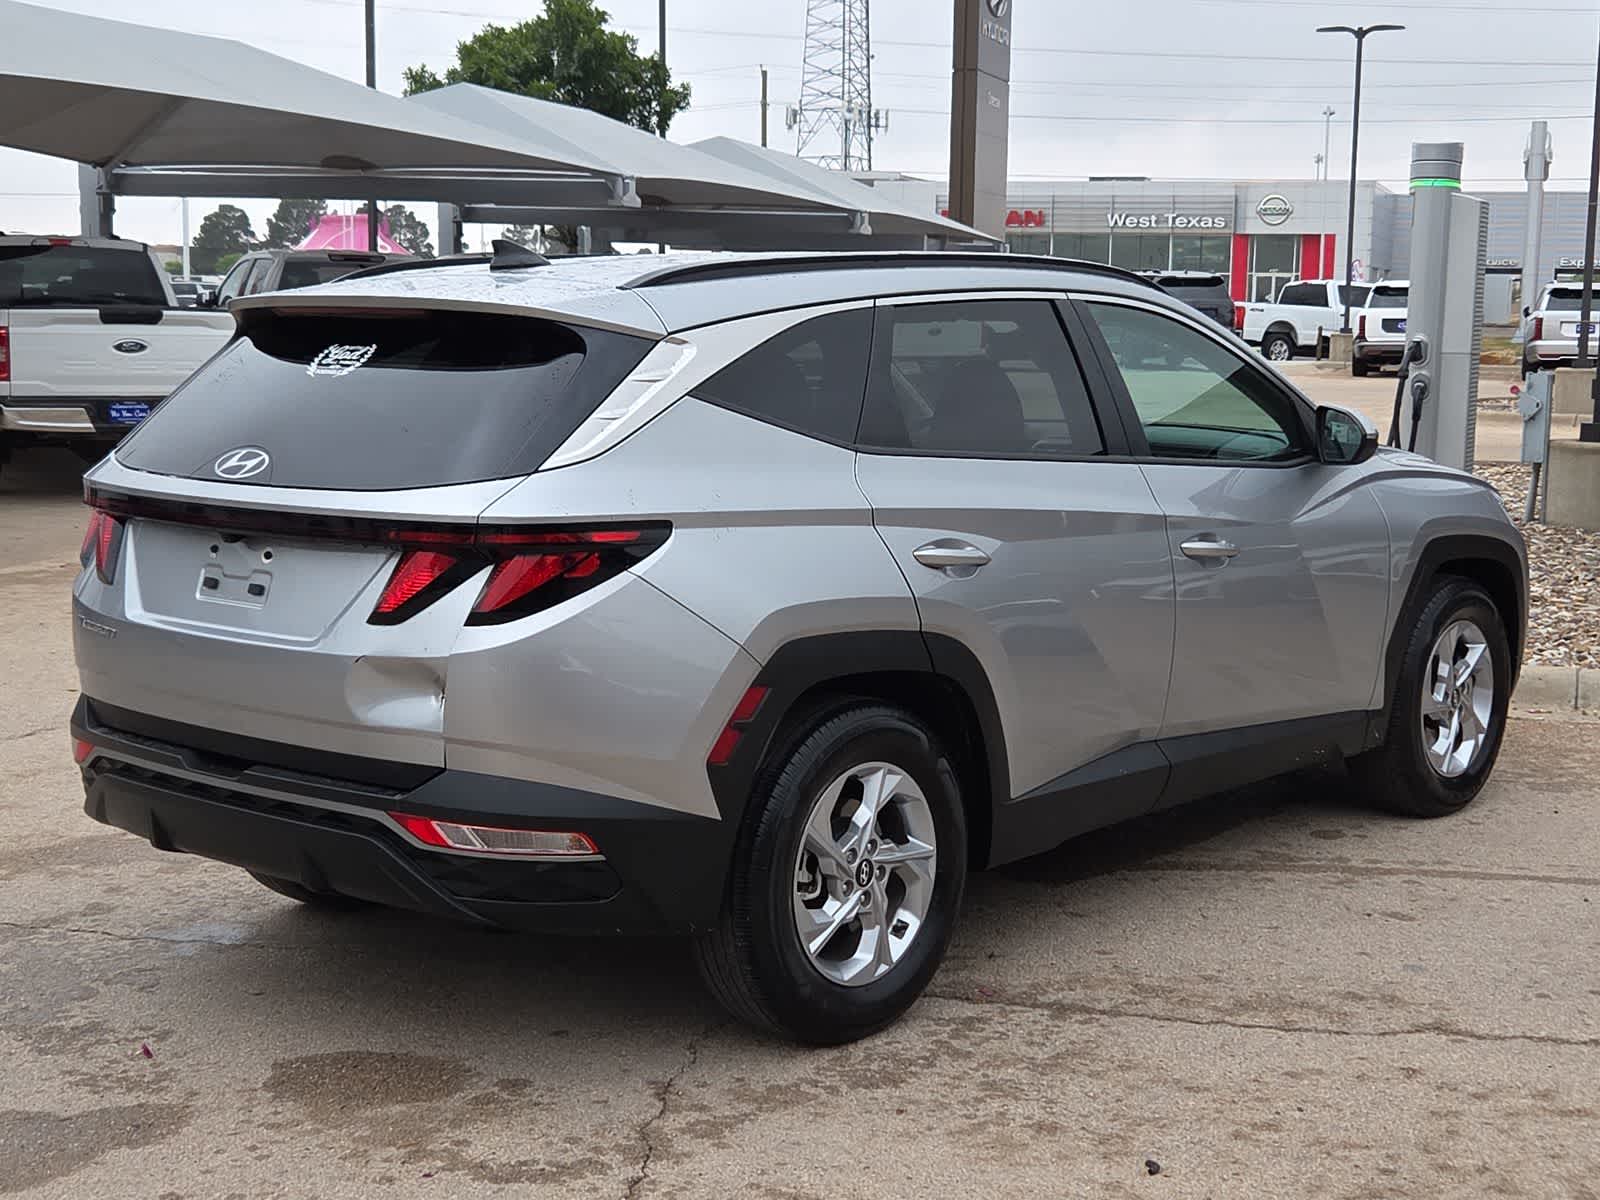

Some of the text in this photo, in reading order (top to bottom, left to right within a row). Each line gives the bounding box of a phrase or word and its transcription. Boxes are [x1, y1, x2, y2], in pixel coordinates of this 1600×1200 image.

[1259, 205, 1290, 215] NISSAN
[1107, 213, 1226, 228] West Texas
